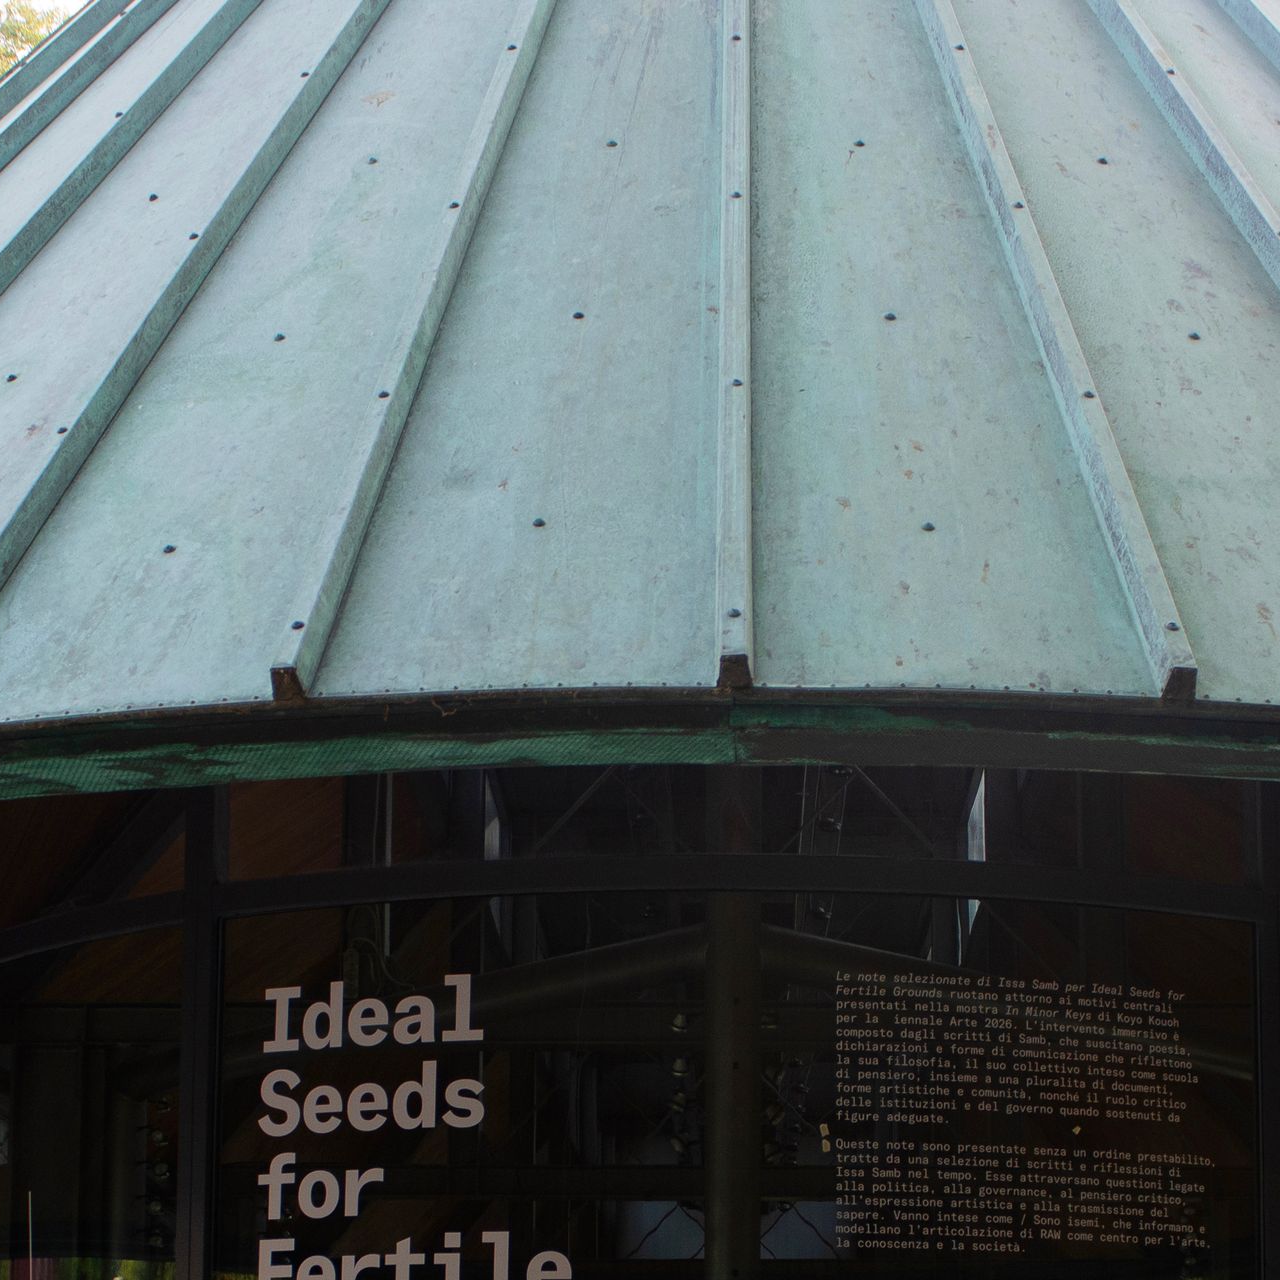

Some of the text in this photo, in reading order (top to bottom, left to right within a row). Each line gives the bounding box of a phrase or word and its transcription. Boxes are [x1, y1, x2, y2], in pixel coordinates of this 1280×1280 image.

[835, 970, 1186, 1000] Le note selezionate di Issa Samb per Ideal Seeds for
[835, 984, 1174, 1013] Fertile Grounds ruotano attorno ai motivi centrali
[263, 973, 484, 1053] Ideal
[835, 999, 1180, 1027] presentati nella mostra In Minor Keys di Koyo Kouoh
[834, 1040, 929, 1053] dichiarazioni
[949, 1043, 985, 1055] forme
[991, 1045, 1005, 1056] di
[1012, 1048, 1099, 1061] comunicazione
[1104, 1052, 1124, 1063] che
[1130, 1054, 1193, 1069] riflettono
[257, 1060, 485, 1137] Seeds
[834, 1137, 1215, 1168] Queste note sono presentate senza un ordine prestabilito,
[257, 1152, 384, 1221] for
